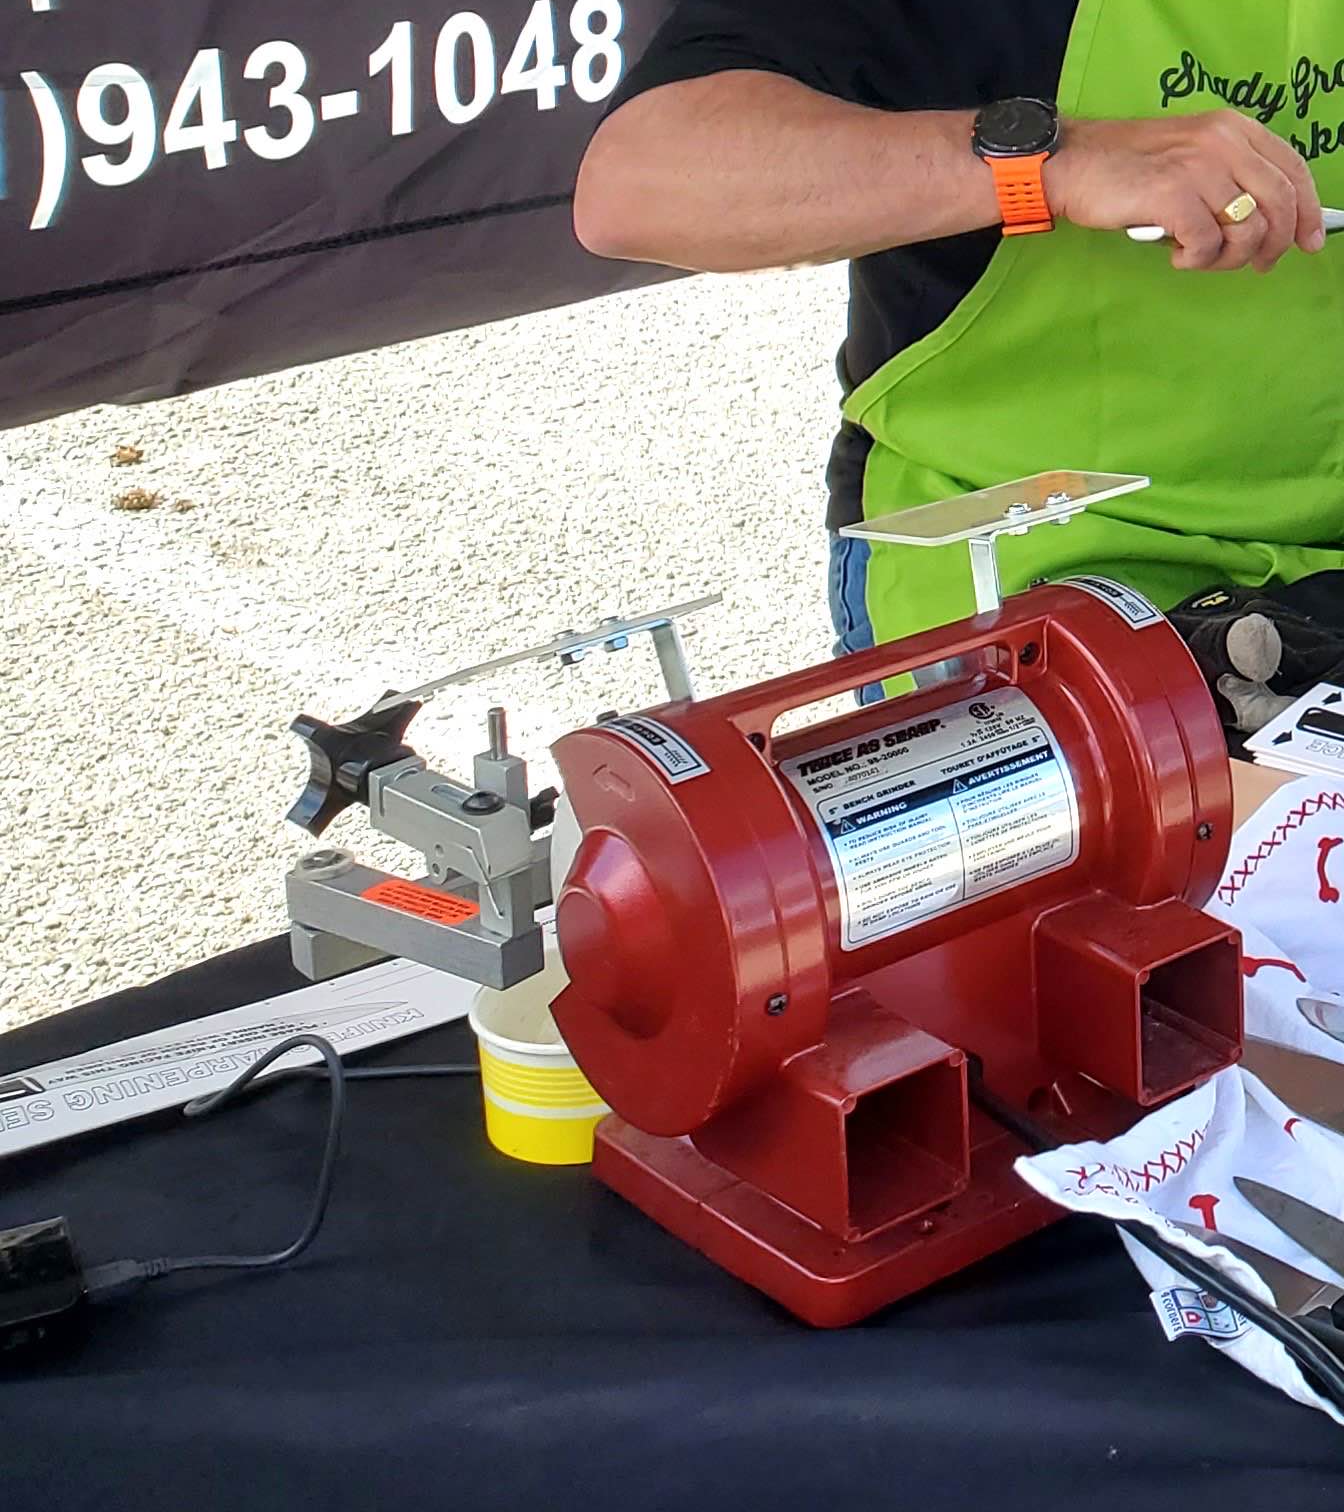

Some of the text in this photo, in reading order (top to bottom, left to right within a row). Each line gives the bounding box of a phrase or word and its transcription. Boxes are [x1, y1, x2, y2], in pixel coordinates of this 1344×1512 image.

[1160, 50, 1288, 123] Shady
[806, 770, 844, 786] MODEL
[968, 750, 1049, 786] AVERTISSEMENT
[842, 793, 875, 810] BENCH
[876, 780, 916, 798] GRINDER
[856, 801, 908, 824] WARNING
[0, 1099, 55, 1133] SE
